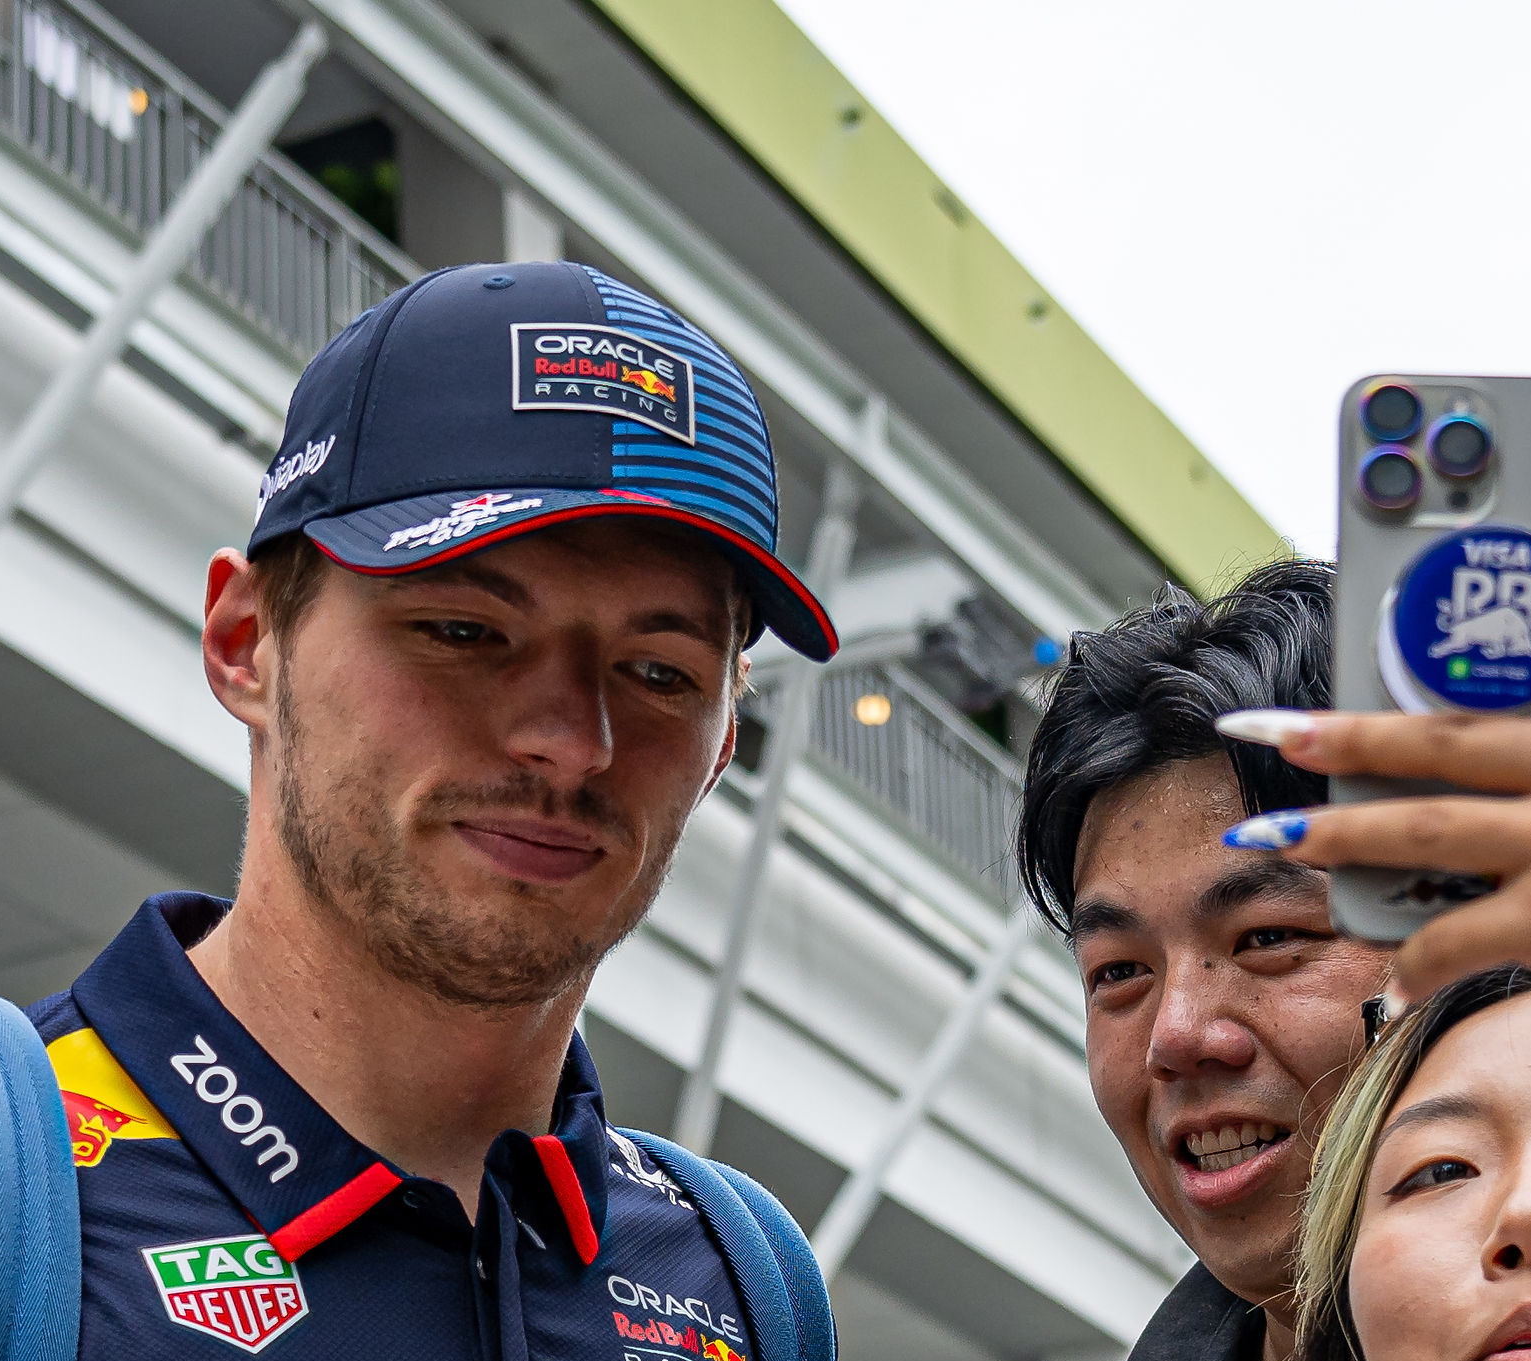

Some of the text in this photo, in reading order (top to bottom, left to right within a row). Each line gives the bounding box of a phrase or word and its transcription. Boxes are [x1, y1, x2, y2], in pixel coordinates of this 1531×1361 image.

[534, 335, 676, 381] ORACLE
[535, 358, 618, 379] Red Bull
[535, 383, 677, 422] RACING
[170, 1035, 299, 1183] zoom
[159, 1242, 285, 1283] TAG
[173, 1286, 298, 1343] HEUER
[607, 1276, 743, 1343] ORACLE
